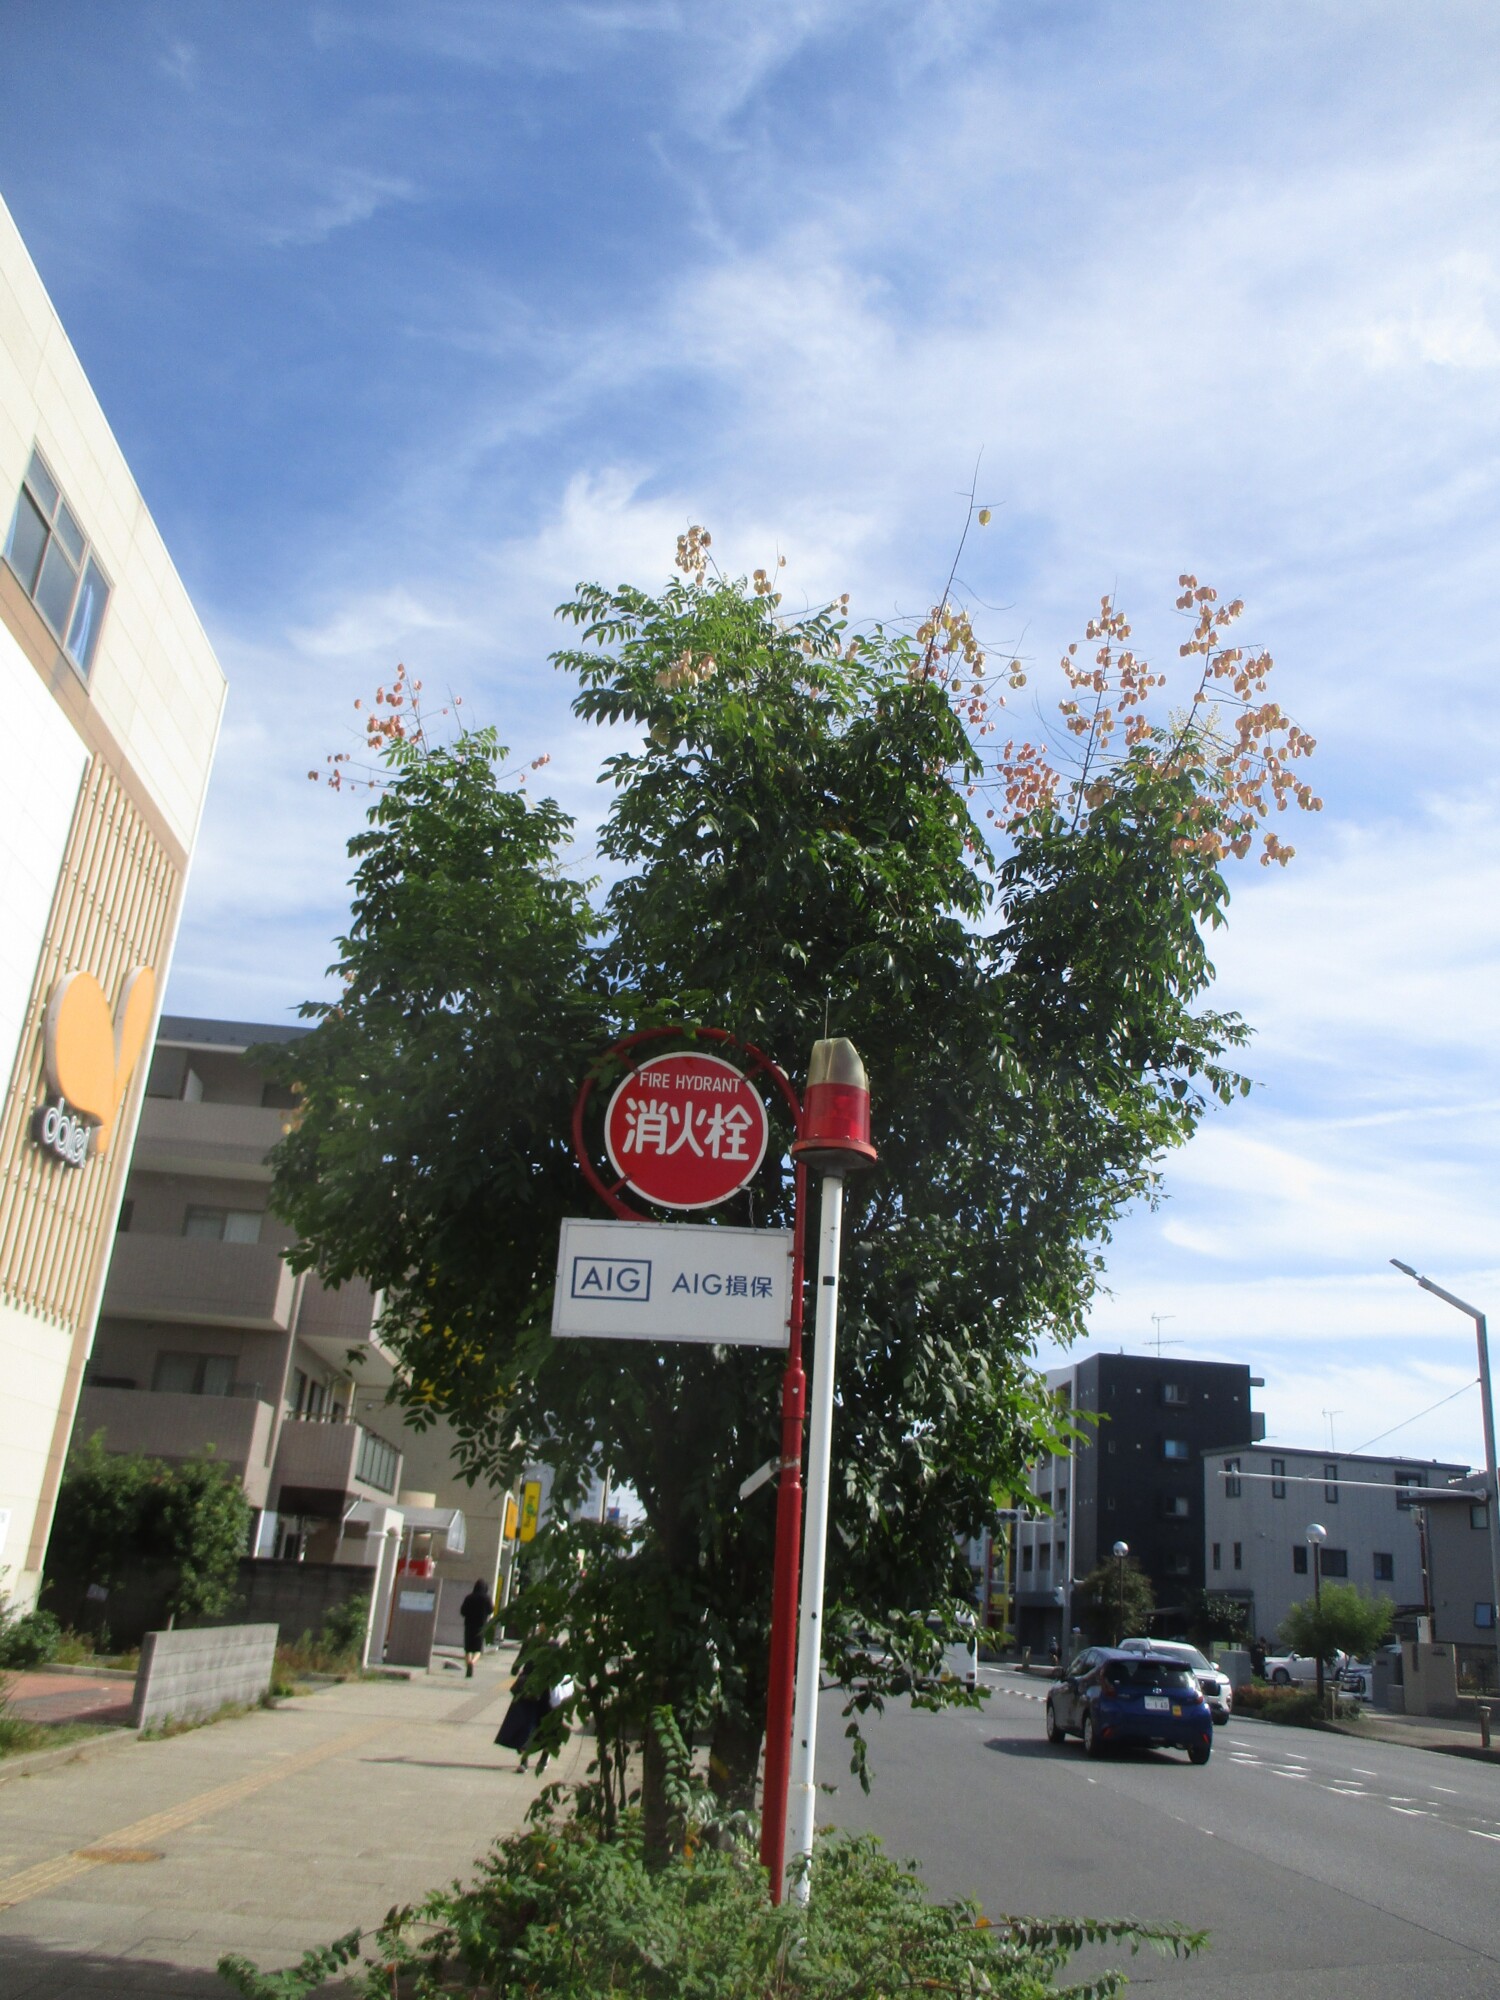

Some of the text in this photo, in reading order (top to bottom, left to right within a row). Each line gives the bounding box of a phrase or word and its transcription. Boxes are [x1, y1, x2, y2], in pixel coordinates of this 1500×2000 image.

[639, 1072, 741, 1093] FIRE HYDRANT
[622, 1097, 753, 1161] 消火栓
[580, 1266, 641, 1292] AIG
[672, 1272, 773, 1299] AIG損保
